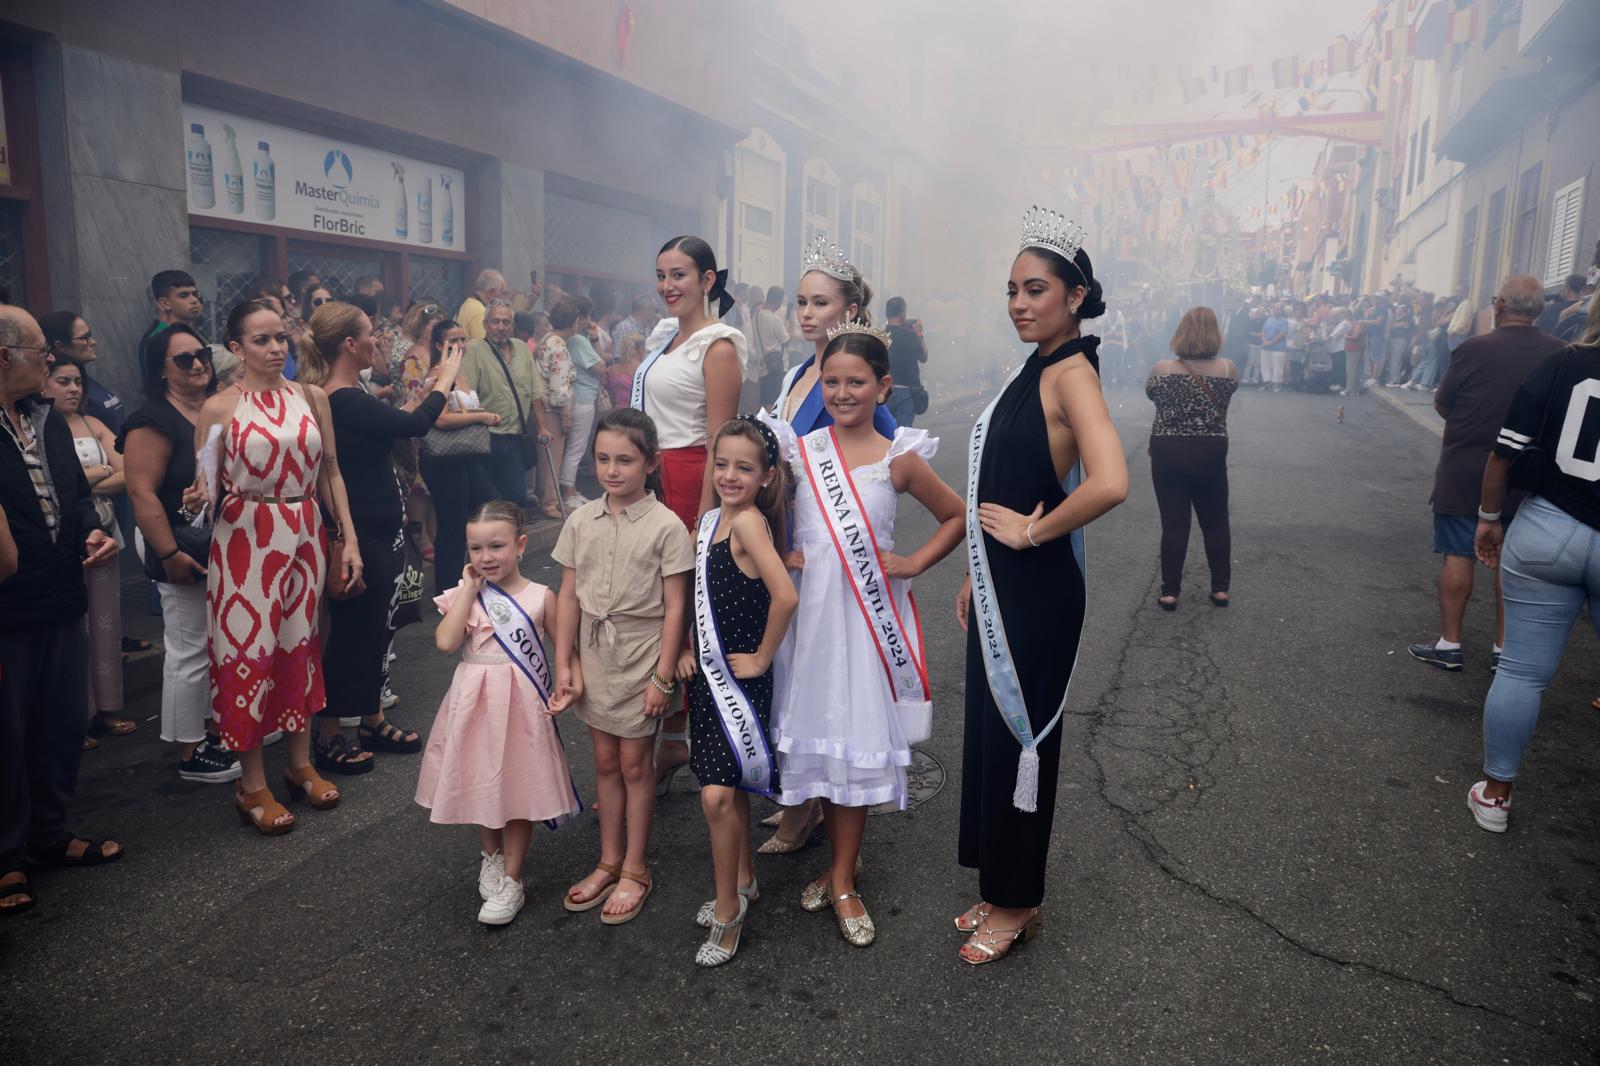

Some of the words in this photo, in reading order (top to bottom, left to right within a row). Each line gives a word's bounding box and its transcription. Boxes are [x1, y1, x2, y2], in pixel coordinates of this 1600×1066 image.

[313, 214, 366, 236] FlorBric
[971, 422, 983, 476] REINA
[818, 458, 851, 522] REINA
[843, 522, 884, 620] INFANTIL
[881, 621, 908, 668] 2024
[970, 544, 990, 615] FIESTAS
[984, 618, 1001, 660] 2024
[699, 614, 714, 666] DAMA
[710, 667, 728, 692] DE
[723, 694, 756, 760] HONOR
